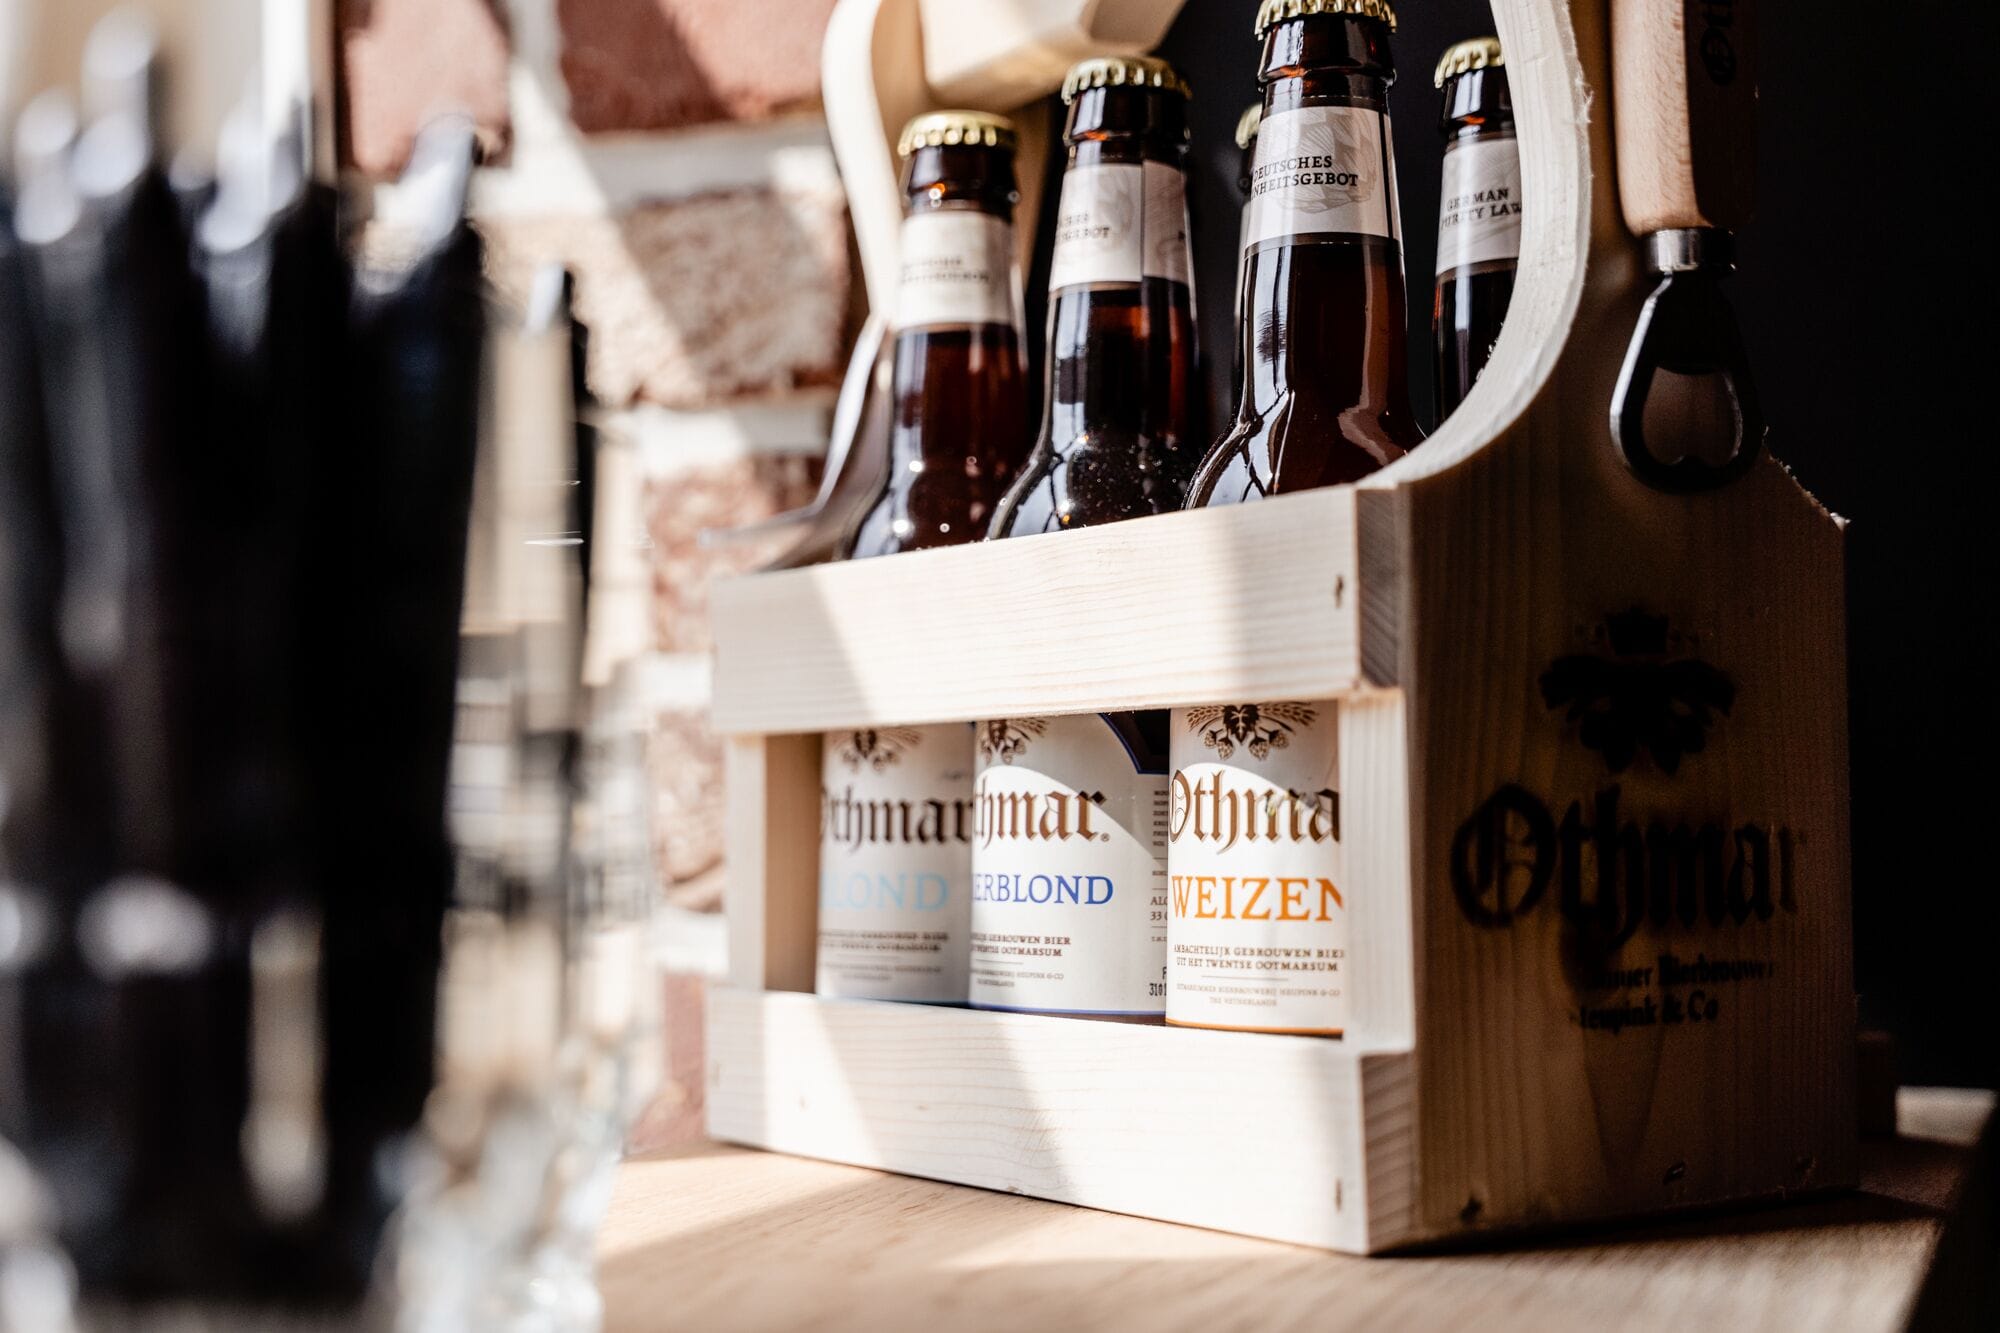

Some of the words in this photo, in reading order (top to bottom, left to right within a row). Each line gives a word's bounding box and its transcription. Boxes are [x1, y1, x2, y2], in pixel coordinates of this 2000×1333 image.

[1253, 155, 1333, 182] DEUTSCHES
[1447, 187, 1509, 211] GERMAN
[1441, 207, 1484, 230] PURTY
[822, 783, 974, 853] thmar
[1451, 784, 1803, 951] Othmar
[1172, 875, 1343, 921] WEIZEN
[1044, 936, 1071, 945] BIER
[1234, 946, 1311, 958] GEBROUWEN
[1176, 956, 1187, 966] UIT
[1188, 957, 1203, 968] HET
[1205, 958, 1252, 970] TWENTSE
[1256, 960, 1338, 972] OOTMARSUM
[1687, 989, 1720, 1022] Co
